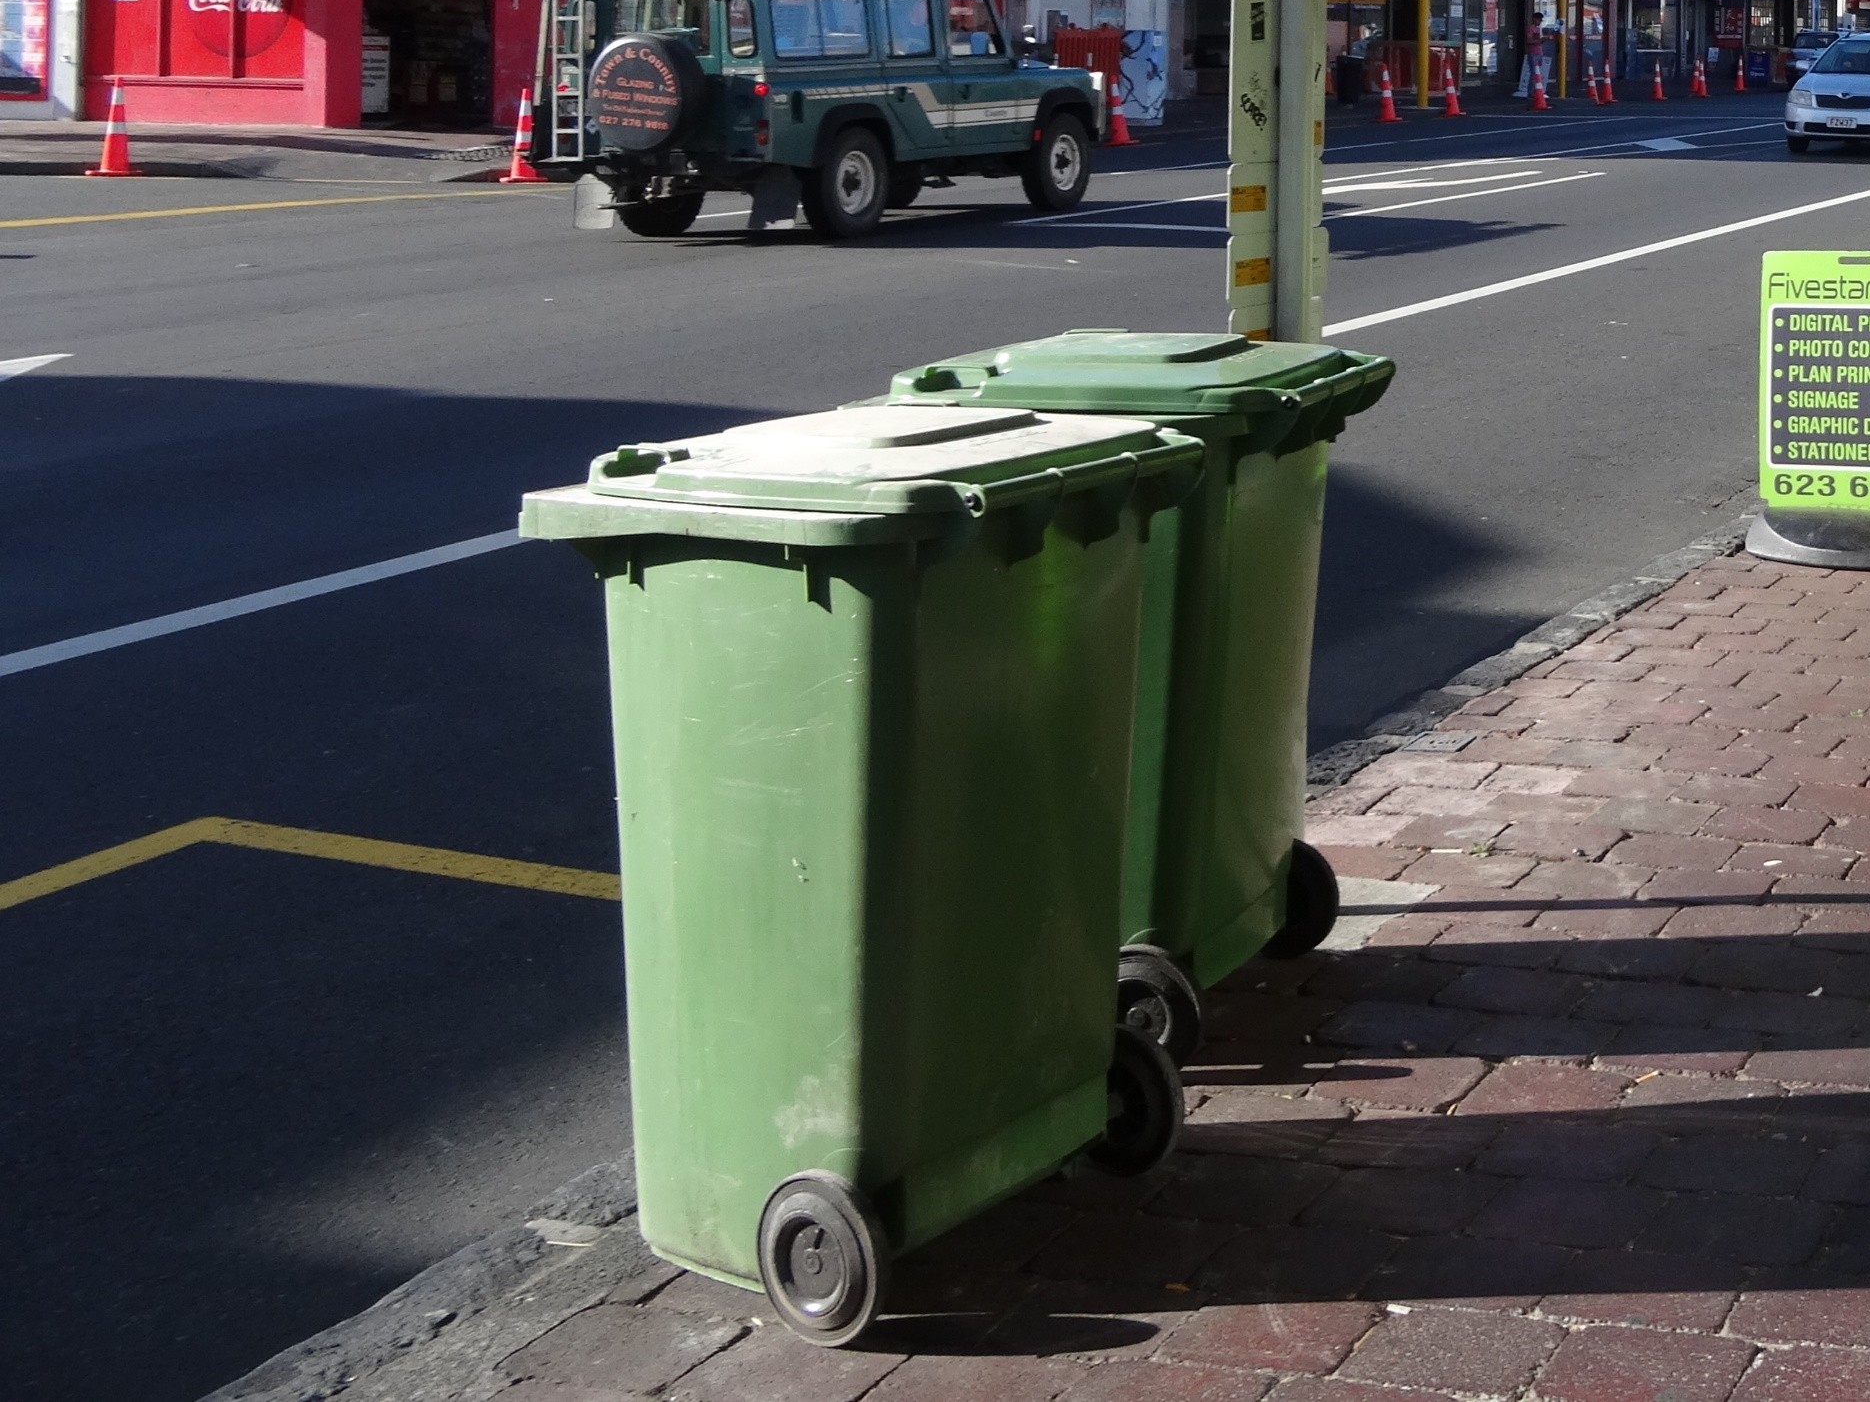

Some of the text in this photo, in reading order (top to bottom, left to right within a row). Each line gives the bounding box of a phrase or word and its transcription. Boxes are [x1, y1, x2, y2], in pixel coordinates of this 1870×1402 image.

[595, 47, 677, 94] Town & Country
[1789, 314, 1853, 332] DIGITAL
[1789, 340, 1843, 358] PHOTO
[1788, 365, 1831, 383] PLAN
[1788, 390, 1859, 409] SIGNAGE
[1788, 416, 1859, 435] GRAPHIC
[1774, 473, 1836, 496] 623
